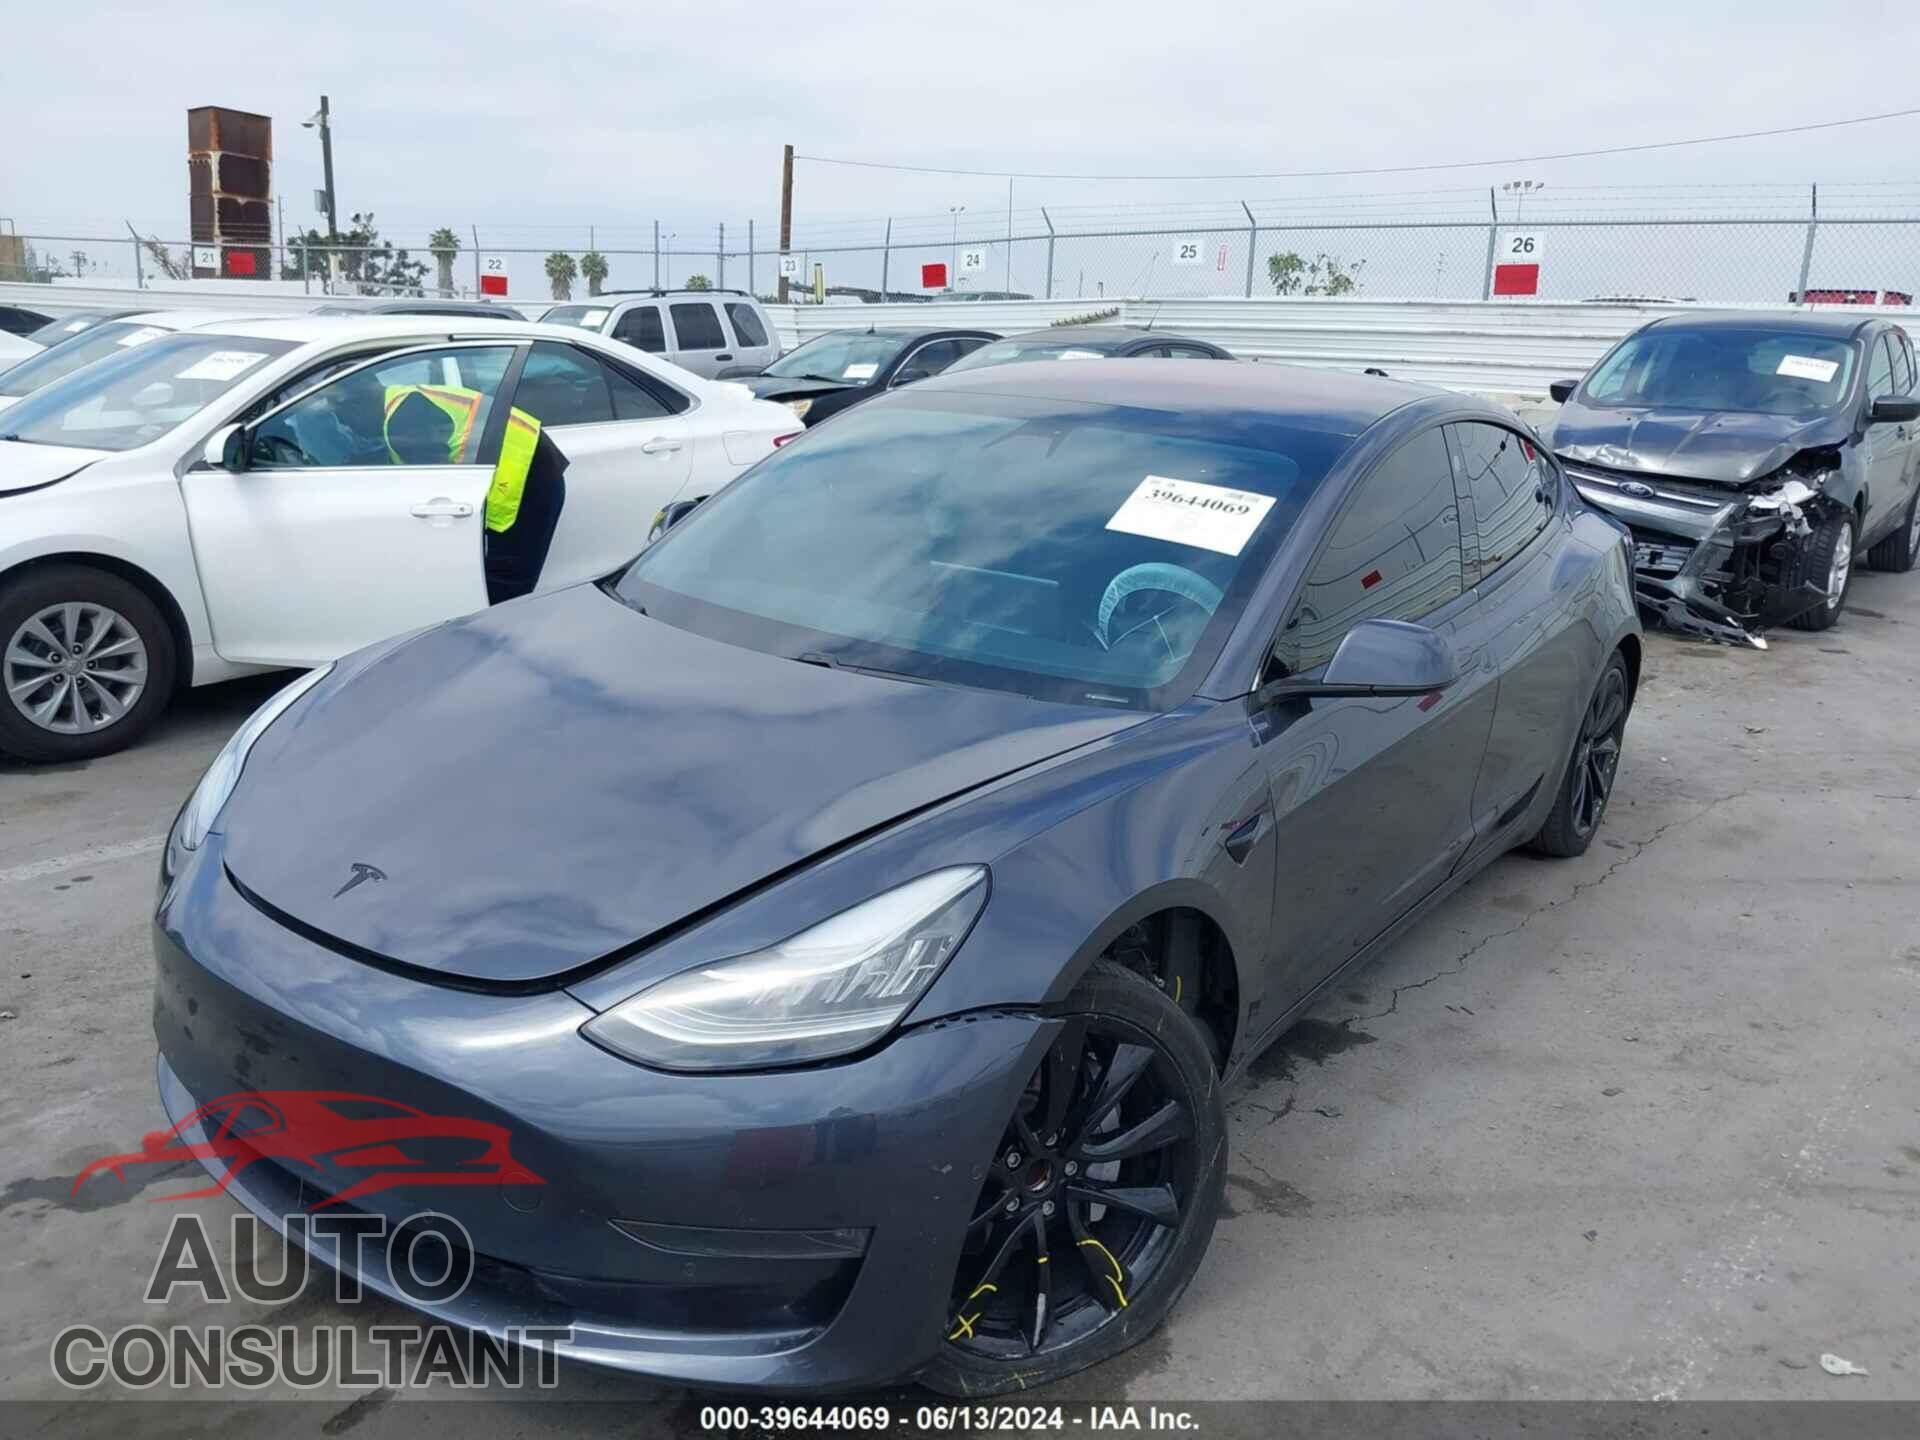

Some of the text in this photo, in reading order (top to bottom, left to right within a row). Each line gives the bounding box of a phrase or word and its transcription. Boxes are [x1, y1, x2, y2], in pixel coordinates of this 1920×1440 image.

[1511, 236, 1535, 253] 26
[201, 252, 215, 263] 21
[1180, 244, 1197, 259] 25
[488, 258, 503, 270] 22
[785, 260, 797, 272] 23
[966, 254, 981, 267] 24
[1150, 487, 1252, 516] 39644069
